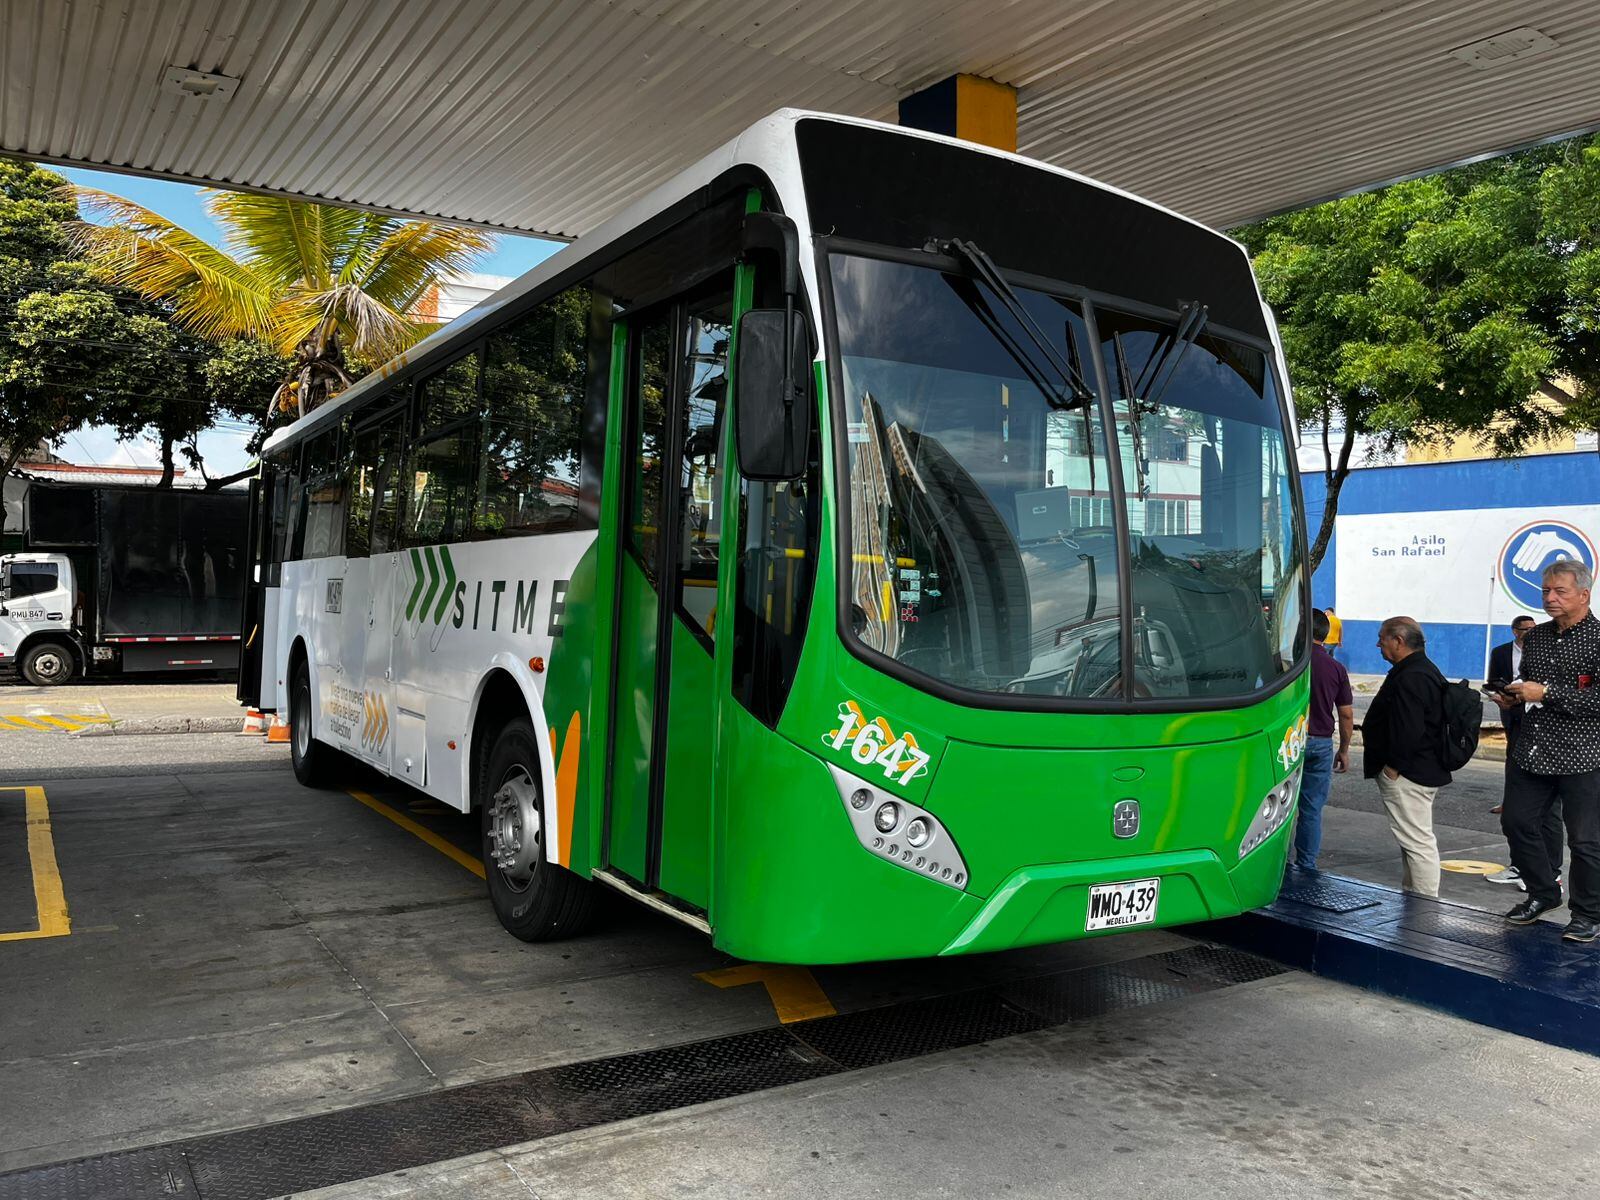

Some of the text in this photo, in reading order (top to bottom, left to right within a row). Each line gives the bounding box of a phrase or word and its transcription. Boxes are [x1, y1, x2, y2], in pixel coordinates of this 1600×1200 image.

[1412, 534, 1446, 545] Asilo
[1371, 545, 1446, 557] San Rafael
[11, 610, 44, 619] PMU 847
[452, 580, 570, 637] SITME
[831, 711, 931, 787] 1647
[1125, 887, 1156, 914] 439
[1105, 914, 1138, 926] MEDELLIN
